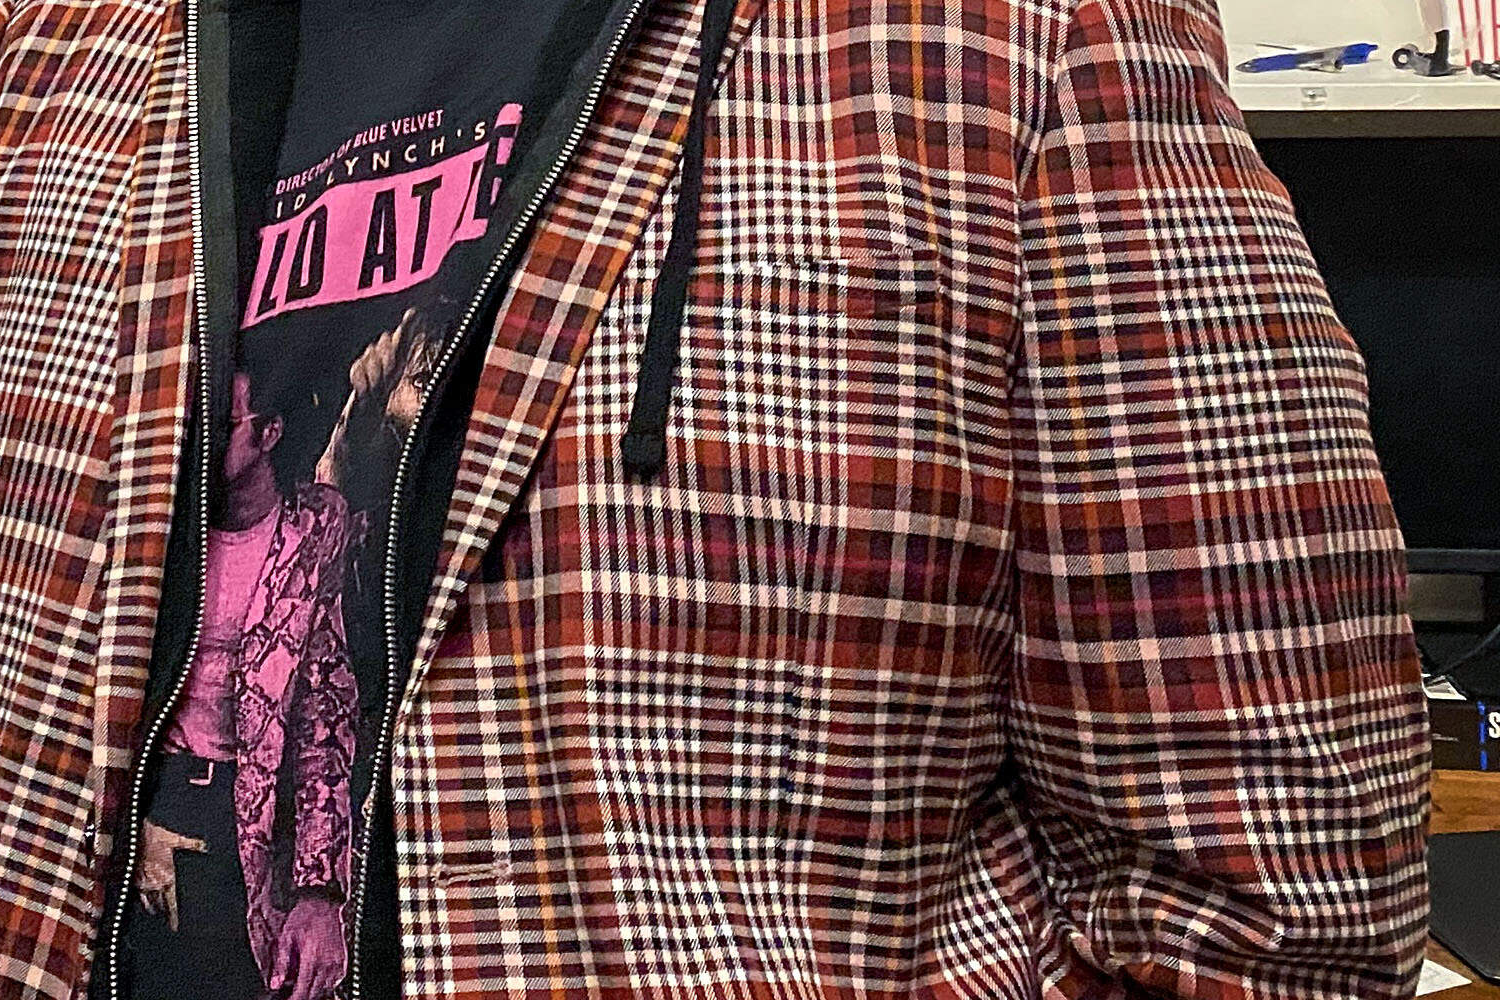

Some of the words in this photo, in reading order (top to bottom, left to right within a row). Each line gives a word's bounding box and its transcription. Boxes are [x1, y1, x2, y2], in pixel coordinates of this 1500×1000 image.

[275, 152, 336, 195] DIRECTOR
[336, 138, 352, 159] OF
[353, 124, 388, 148] BLUE
[391, 109, 444, 137] VELVET
[326, 121, 486, 186] LYNCH'S
[357, 174, 444, 291] AT
